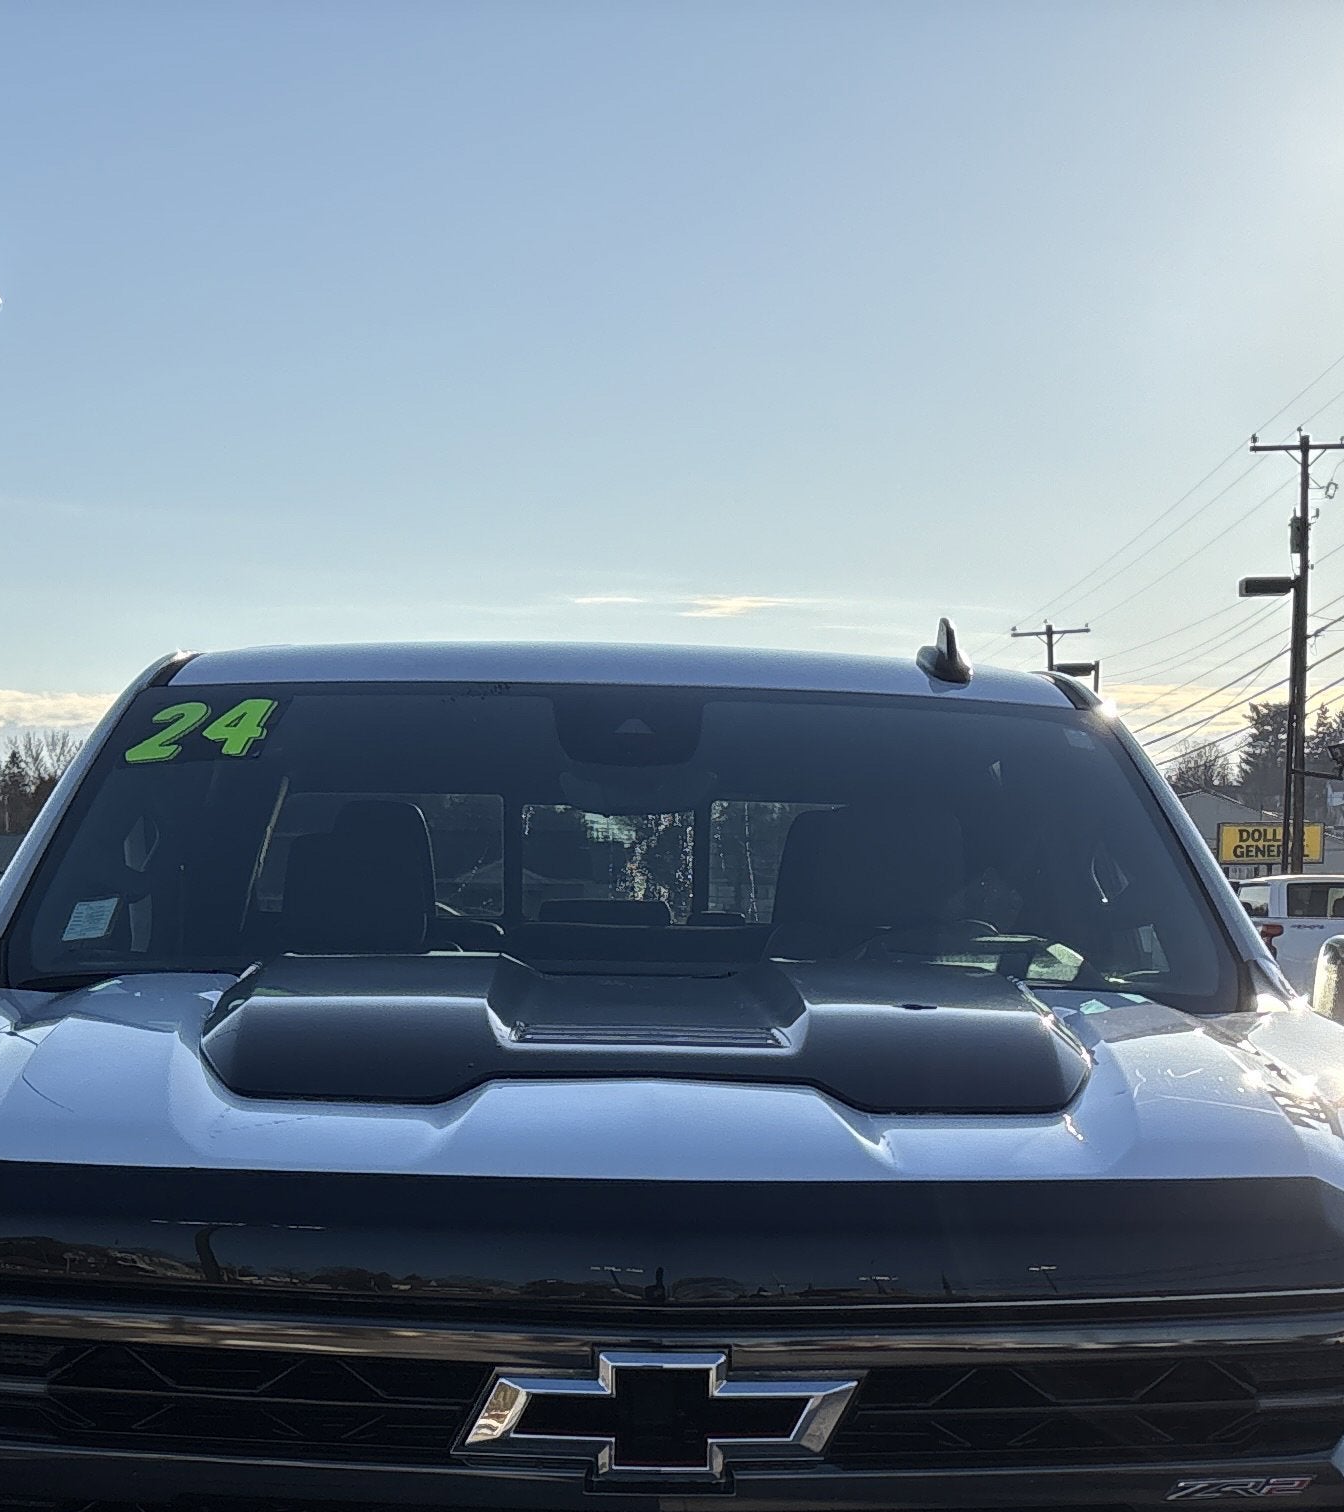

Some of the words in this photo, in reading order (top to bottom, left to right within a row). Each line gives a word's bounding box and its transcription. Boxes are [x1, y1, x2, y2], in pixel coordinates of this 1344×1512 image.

[125, 699, 278, 763] 24
[1238, 828, 1305, 843] DOLL
[1165, 1476, 1317, 1501] ZR2
